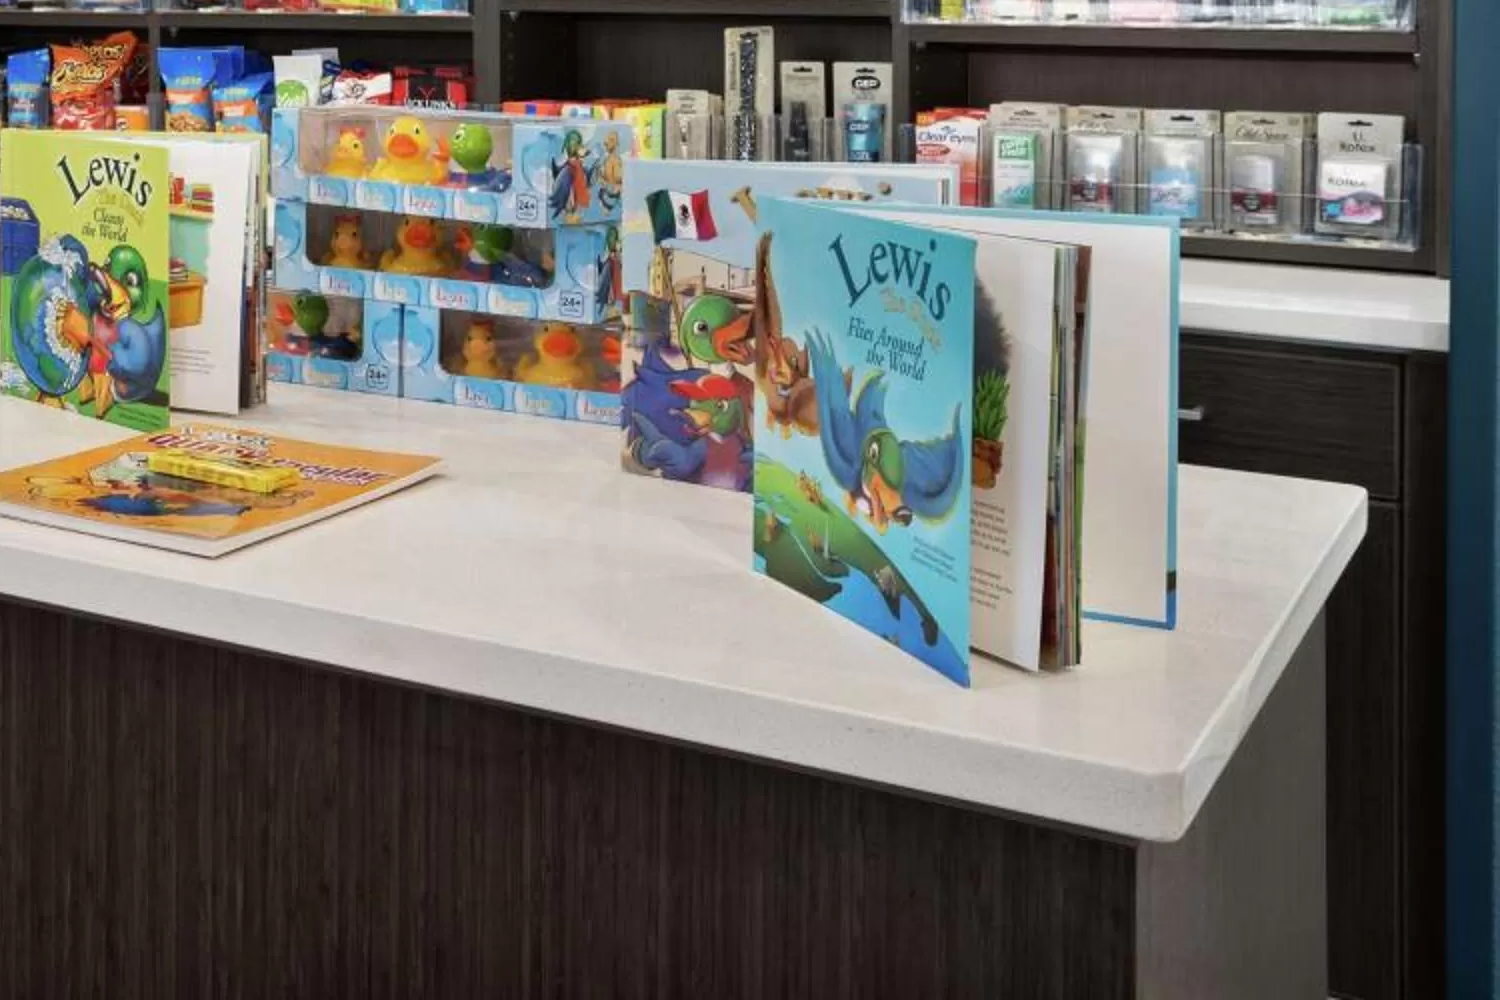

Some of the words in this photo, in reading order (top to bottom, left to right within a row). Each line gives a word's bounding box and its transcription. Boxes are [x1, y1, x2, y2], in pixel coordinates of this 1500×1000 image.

[57, 152, 153, 207] Lewis
[828, 232, 952, 322] Lewis
[848, 316, 874, 343] Flies
[874, 325, 925, 360] Around
[866, 347, 885, 367] the
[888, 350, 927, 382] World
